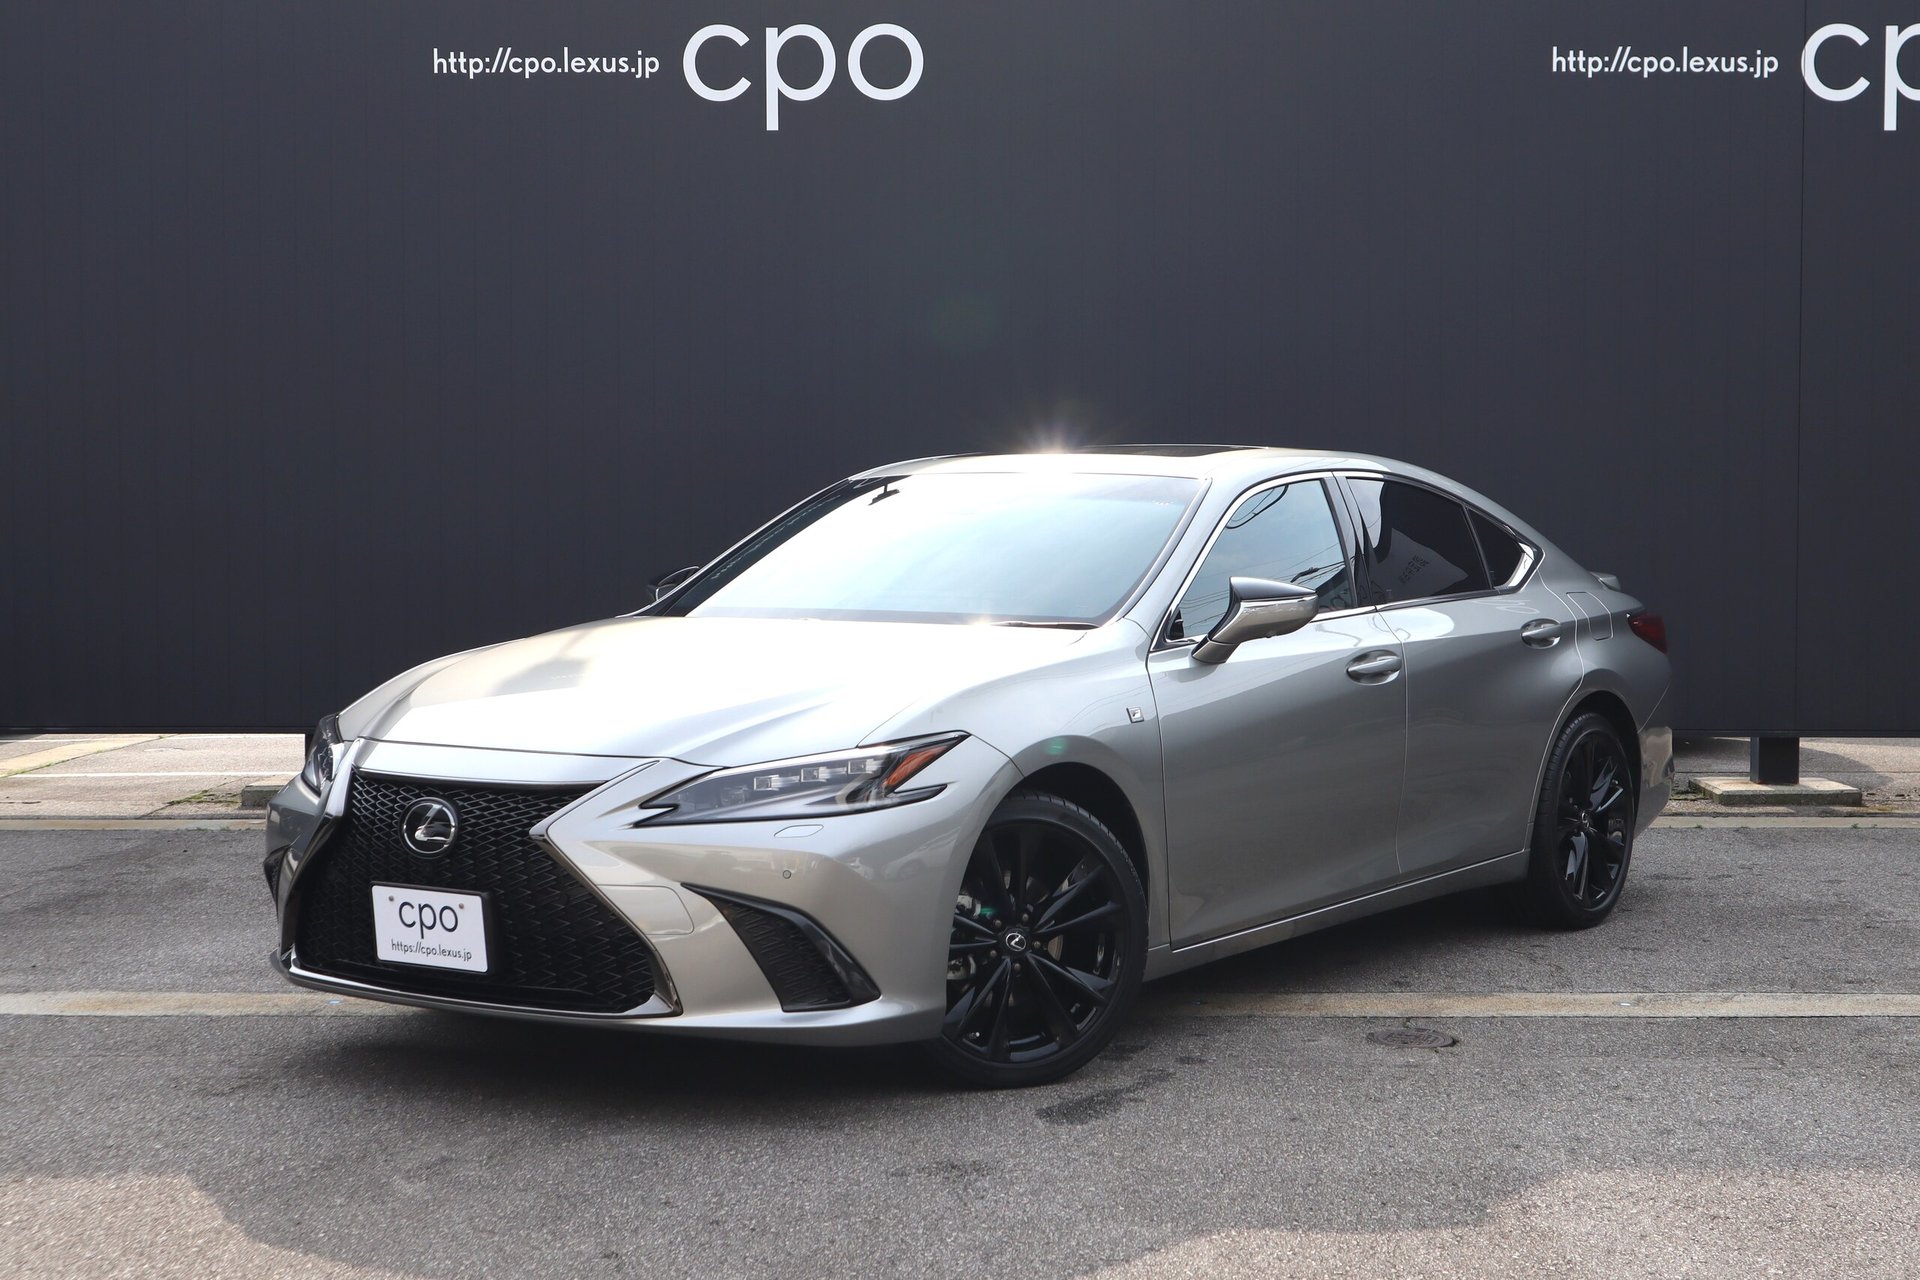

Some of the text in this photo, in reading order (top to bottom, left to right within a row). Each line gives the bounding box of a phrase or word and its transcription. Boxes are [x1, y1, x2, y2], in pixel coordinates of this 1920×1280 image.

[432, 46, 661, 80] http://cpo.lexus.jp
[682, 23, 924, 132] cpo
[1551, 45, 1780, 79] http://cpo.lexus.jp
[398, 901, 459, 940] cpo
[391, 938, 472, 962] https://cpo.lexus.jp
